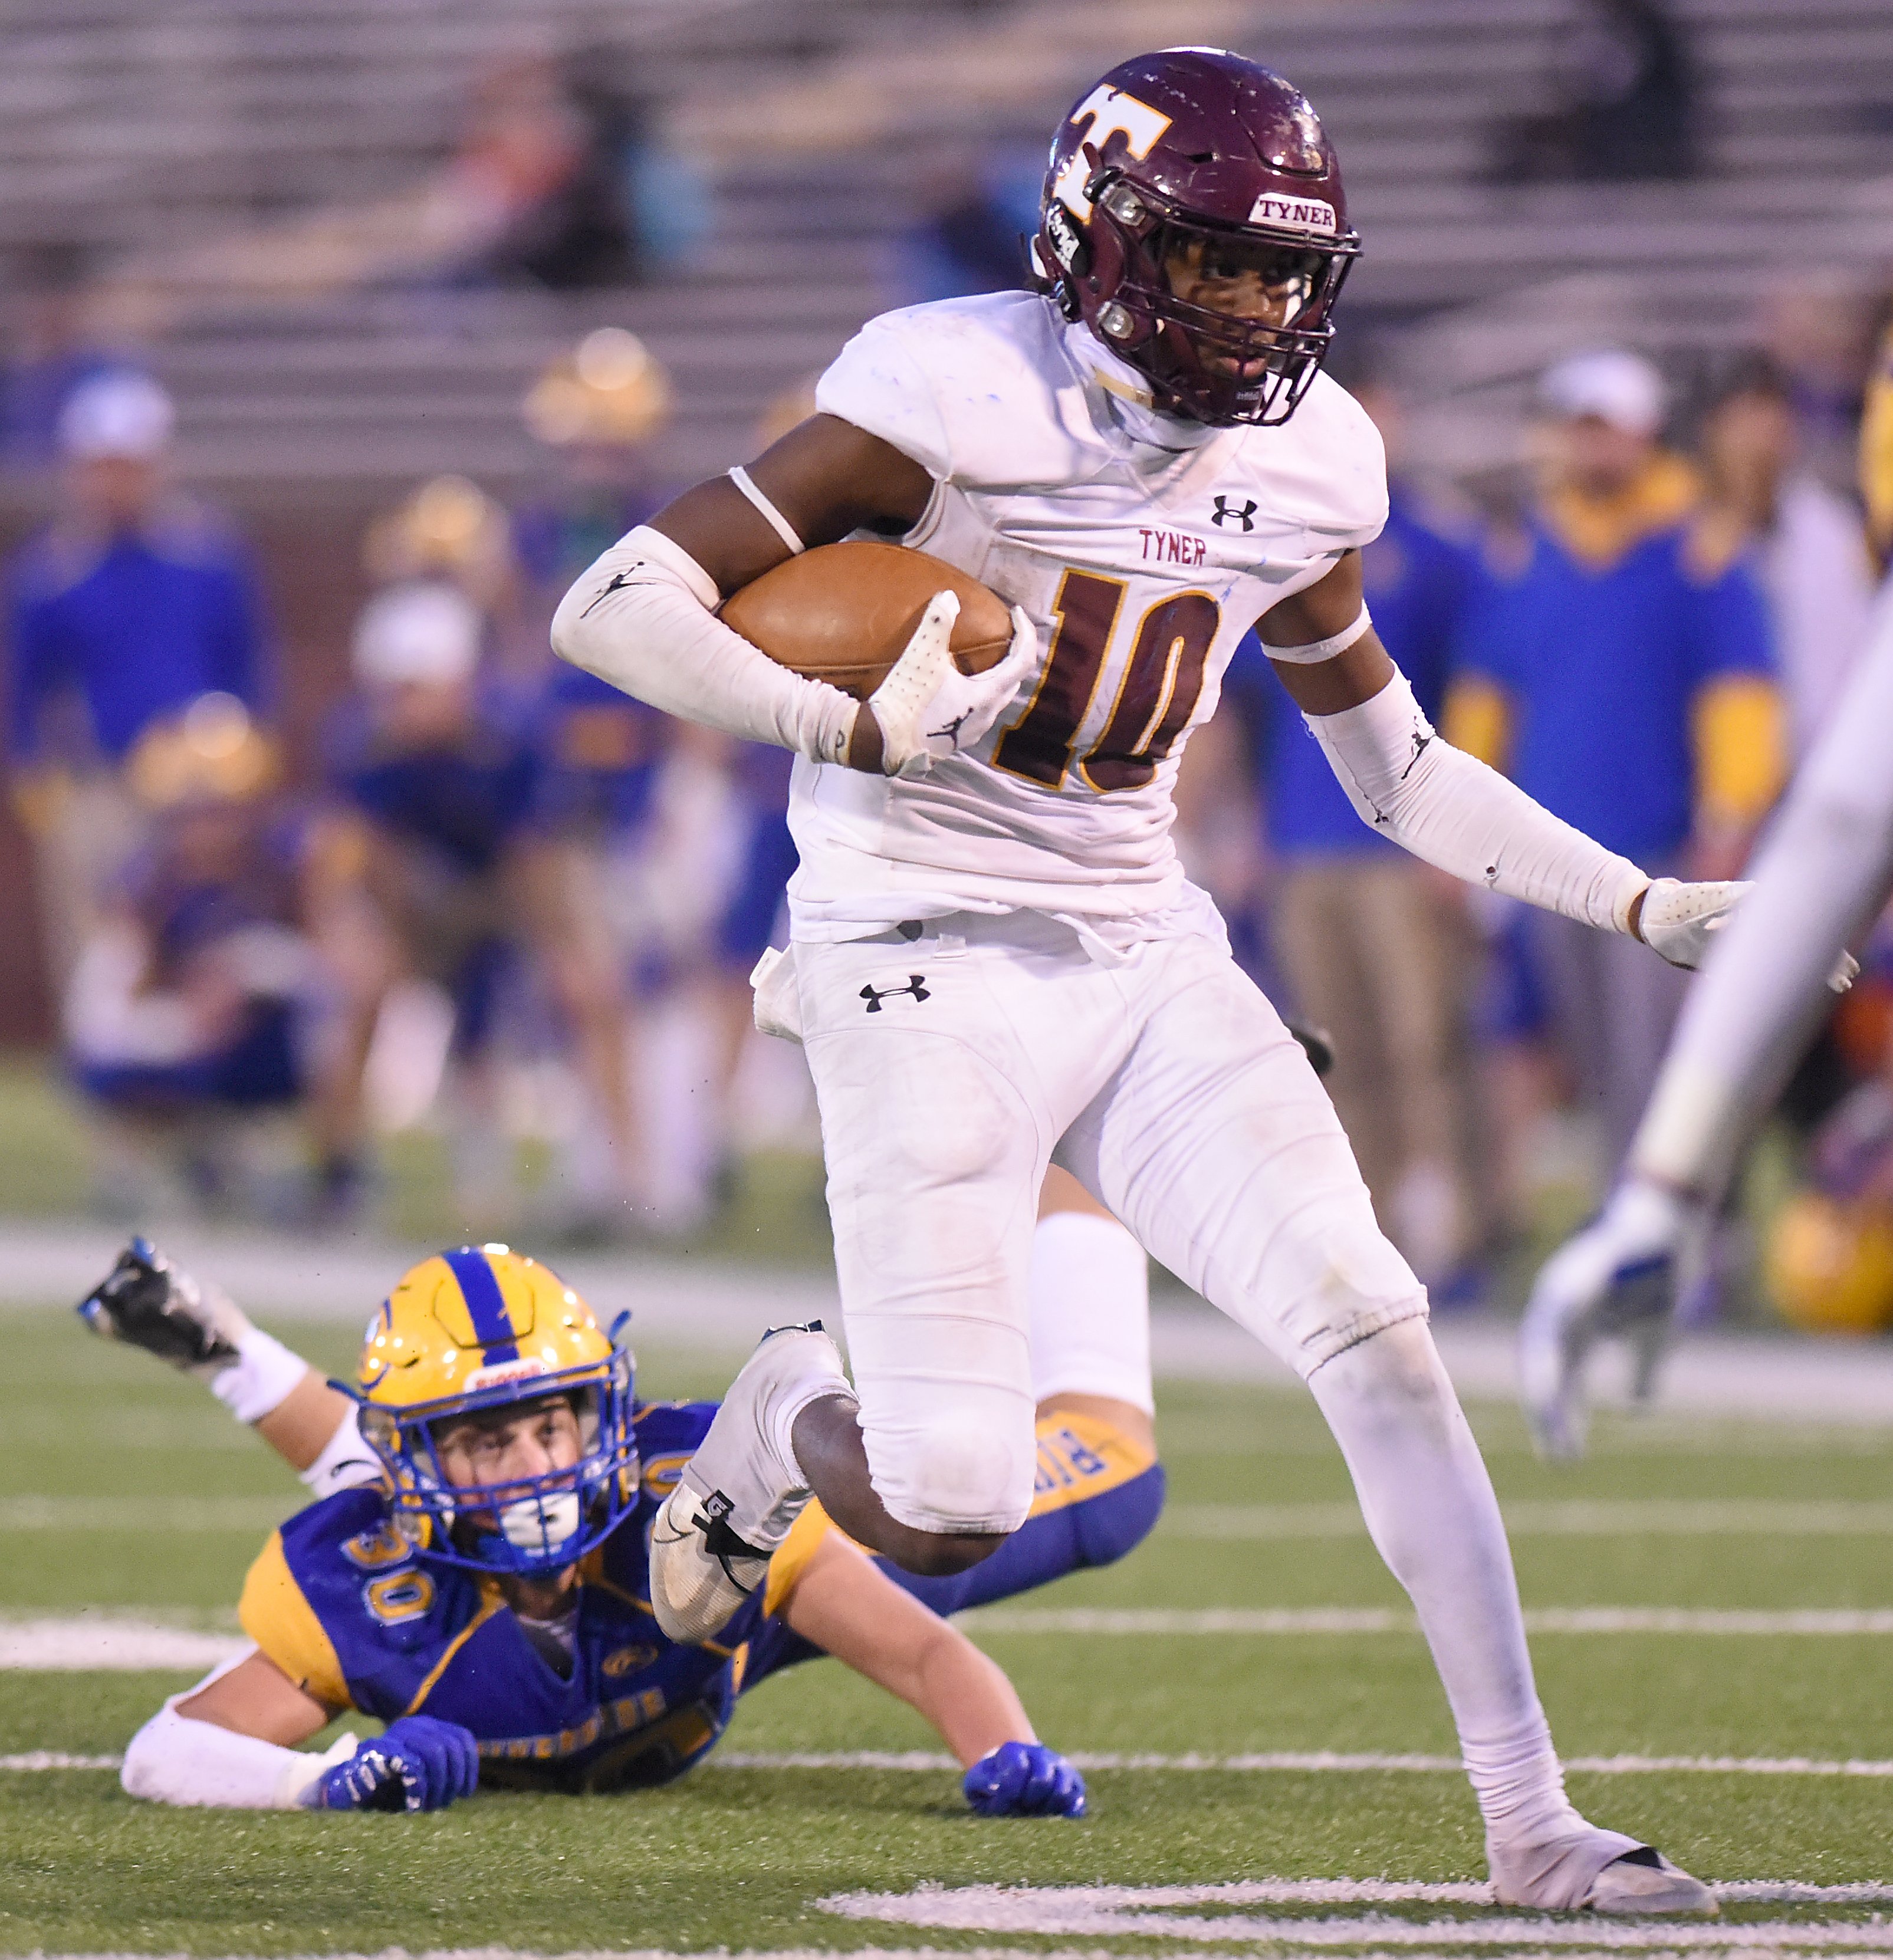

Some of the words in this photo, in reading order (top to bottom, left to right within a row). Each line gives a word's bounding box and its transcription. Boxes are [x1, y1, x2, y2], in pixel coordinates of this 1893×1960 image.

[1051, 83, 1173, 225] T
[1259, 199, 1333, 227] TYNER
[1139, 529, 1207, 566] TYNER
[989, 567, 1222, 794] 10
[338, 1519, 438, 1626] 30
